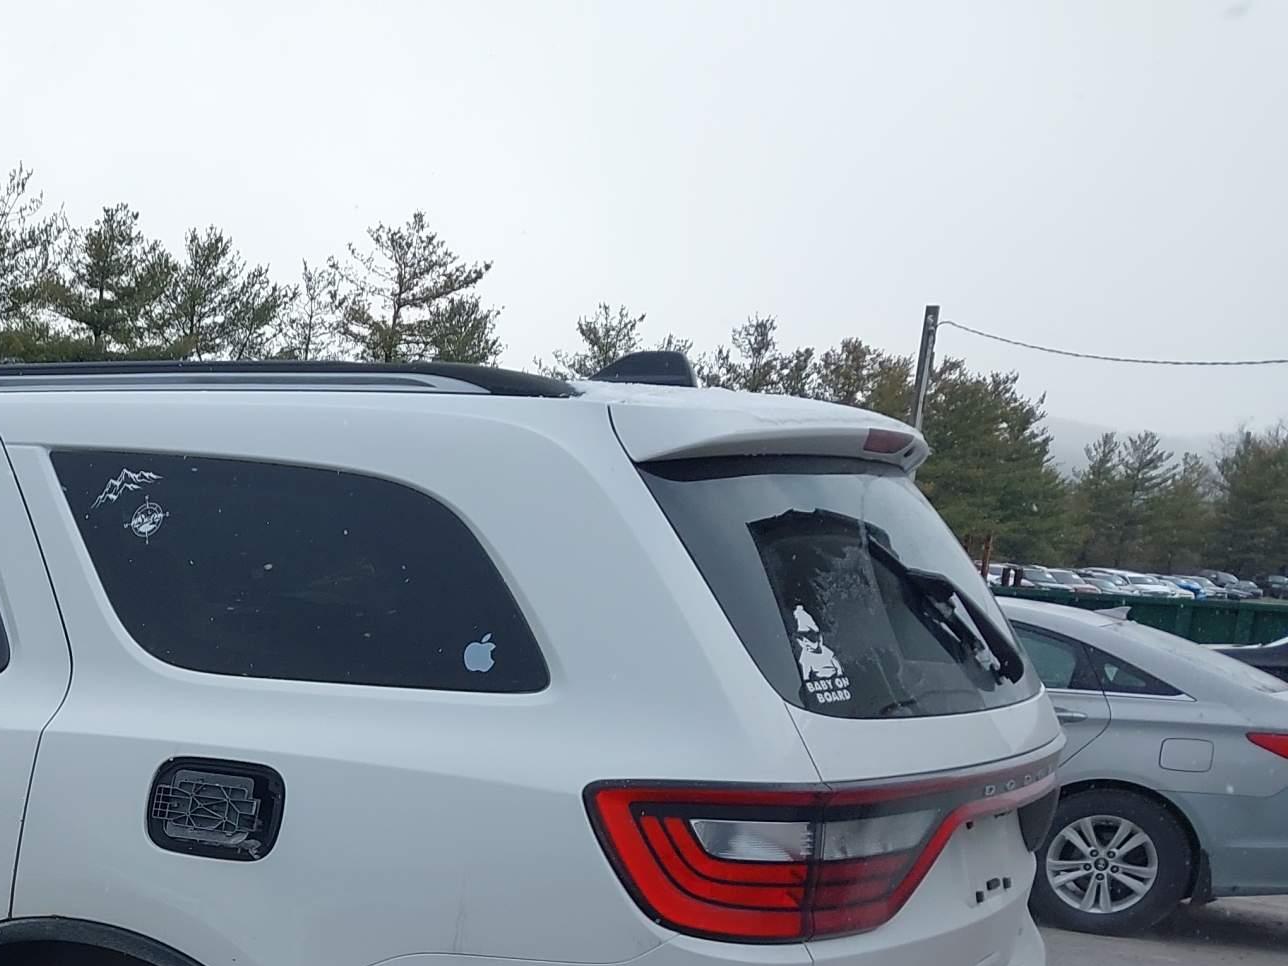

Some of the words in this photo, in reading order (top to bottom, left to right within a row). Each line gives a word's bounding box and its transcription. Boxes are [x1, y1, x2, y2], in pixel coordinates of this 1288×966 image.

[805, 680, 833, 693] BABY
[834, 677, 850, 689] ON
[816, 689, 851, 703] BOARD
